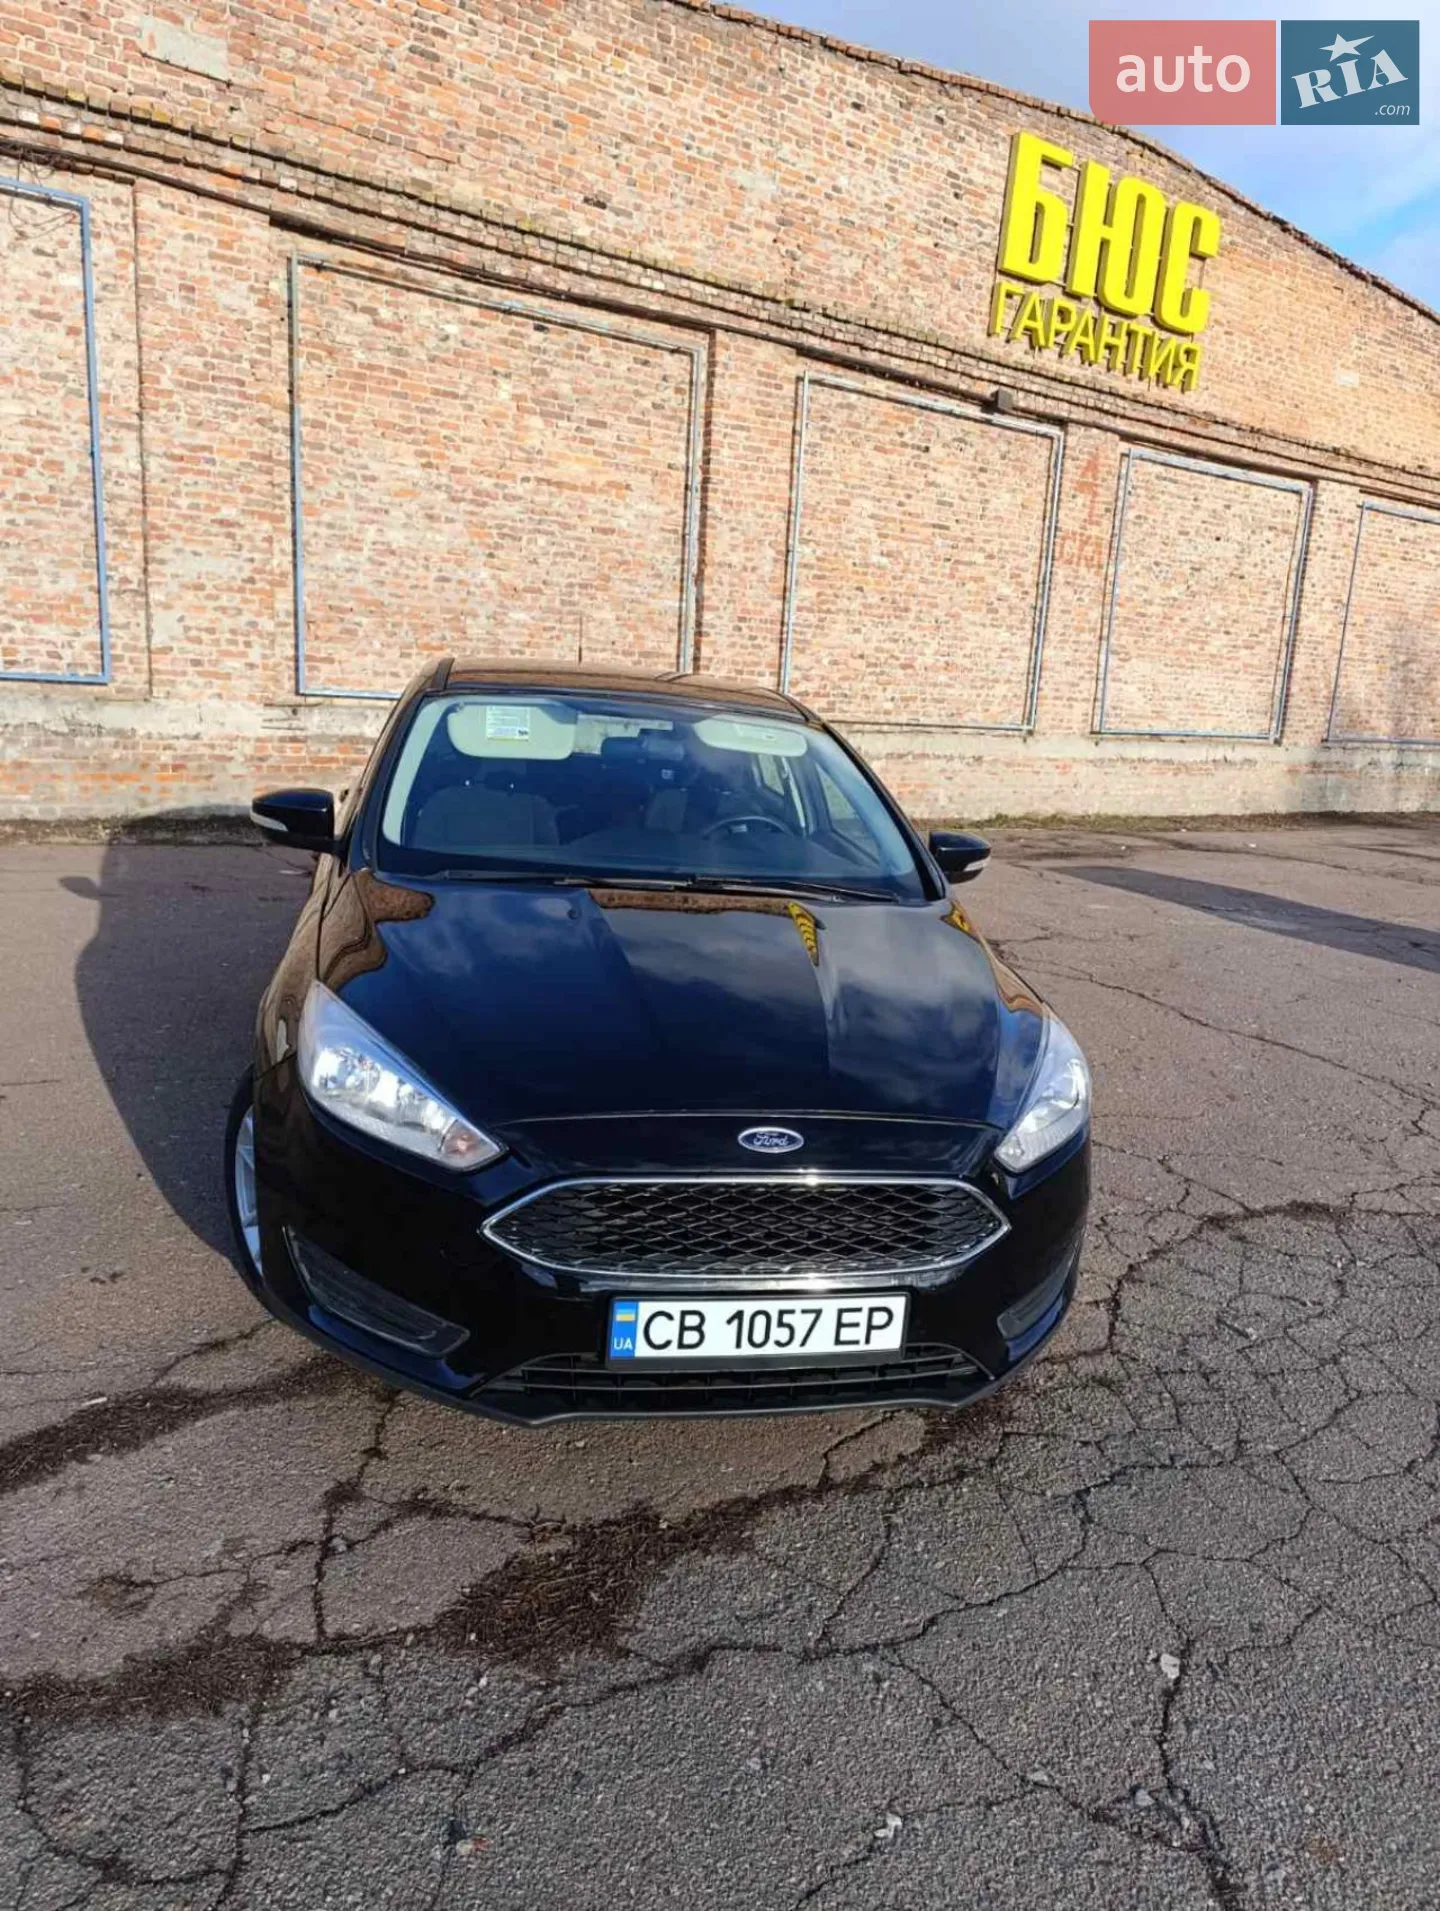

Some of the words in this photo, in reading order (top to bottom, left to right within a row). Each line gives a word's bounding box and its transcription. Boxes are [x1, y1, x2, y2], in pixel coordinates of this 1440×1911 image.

[998, 131, 1221, 335] БЮС
[989, 279, 1202, 391] ГАРАНТИЯ
[753, 1131, 789, 1146] Ford
[613, 1337, 633, 1350] UA
[643, 1310, 706, 1350] CB
[726, 1309, 823, 1349] 1057
[834, 1306, 894, 1346] EP
